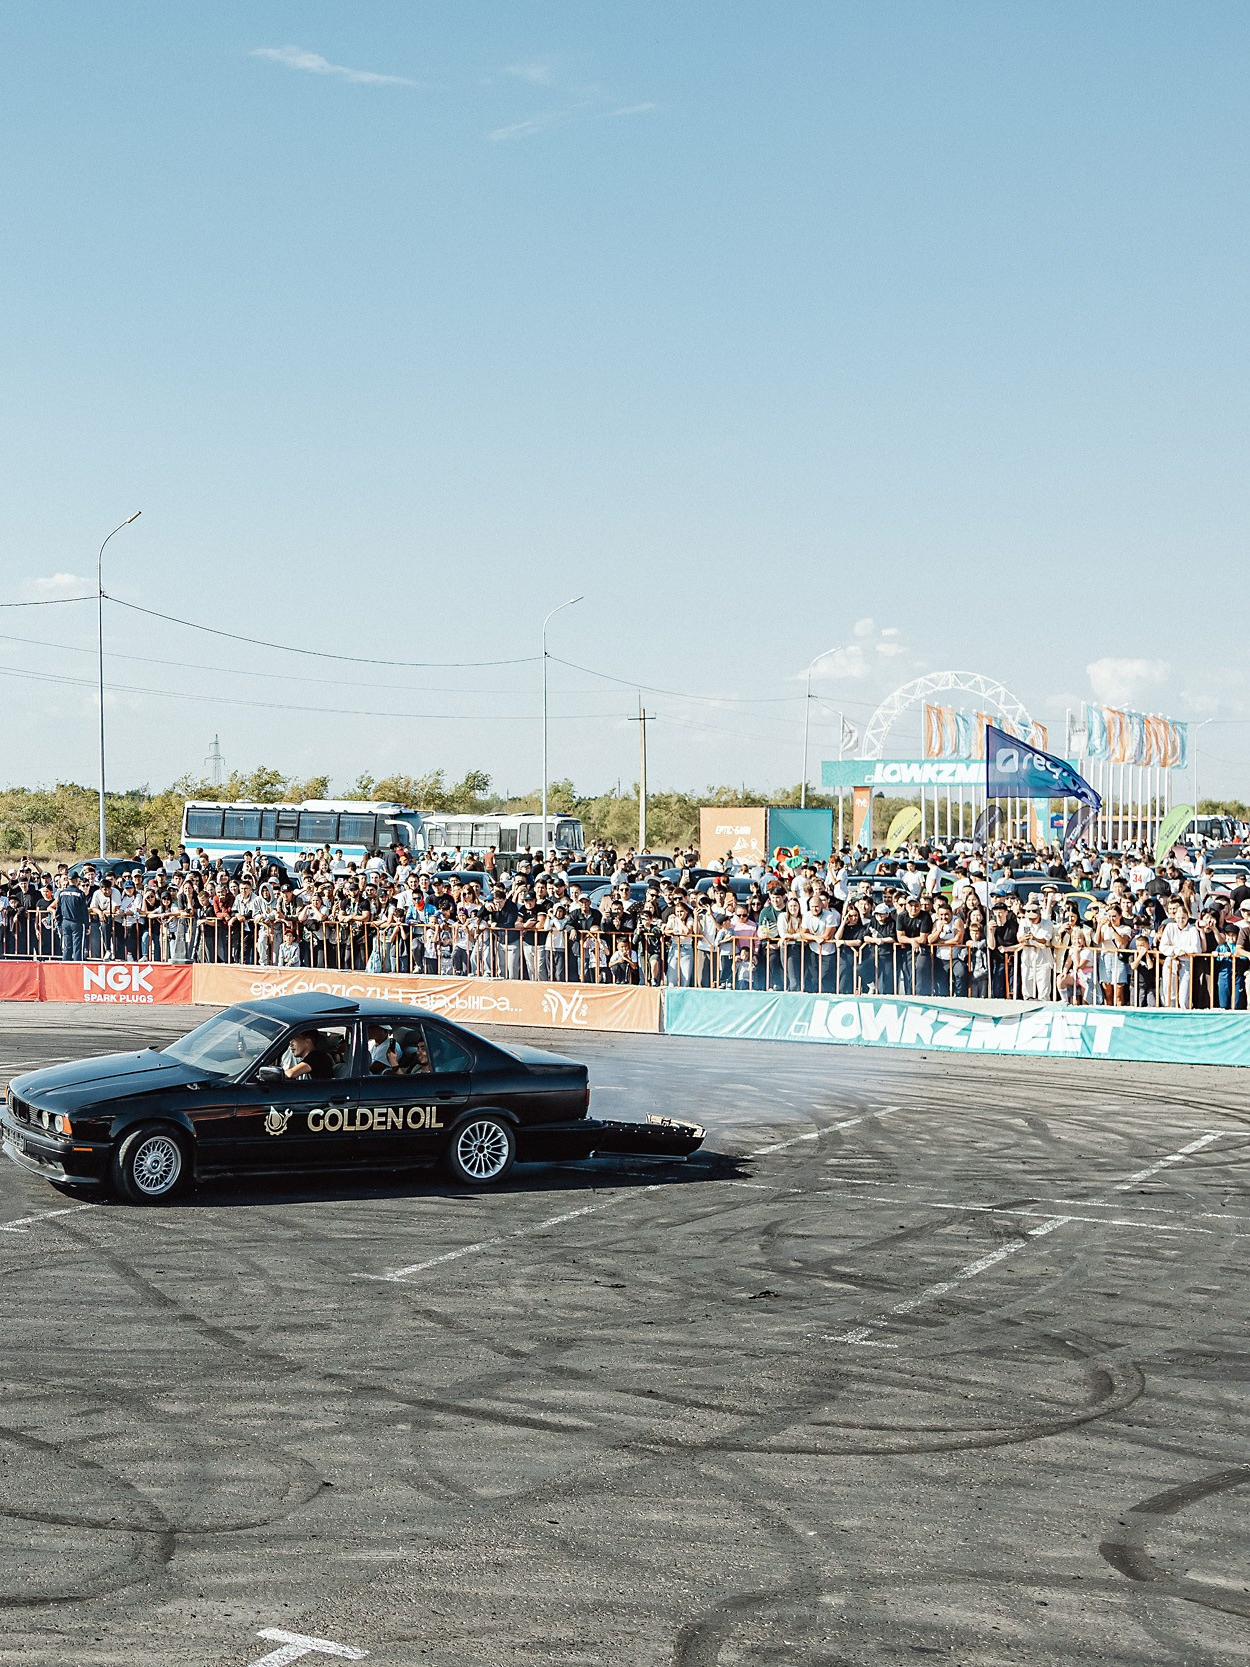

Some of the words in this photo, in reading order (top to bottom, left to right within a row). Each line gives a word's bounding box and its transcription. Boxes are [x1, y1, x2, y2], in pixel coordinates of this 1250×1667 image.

[83, 965, 154, 992] NGK
[83, 993, 117, 1002] SPARK
[119, 994, 154, 1003] PLUGS
[307, 1107, 403, 1132] GOLDEN
[406, 1106, 444, 1129] OIL
